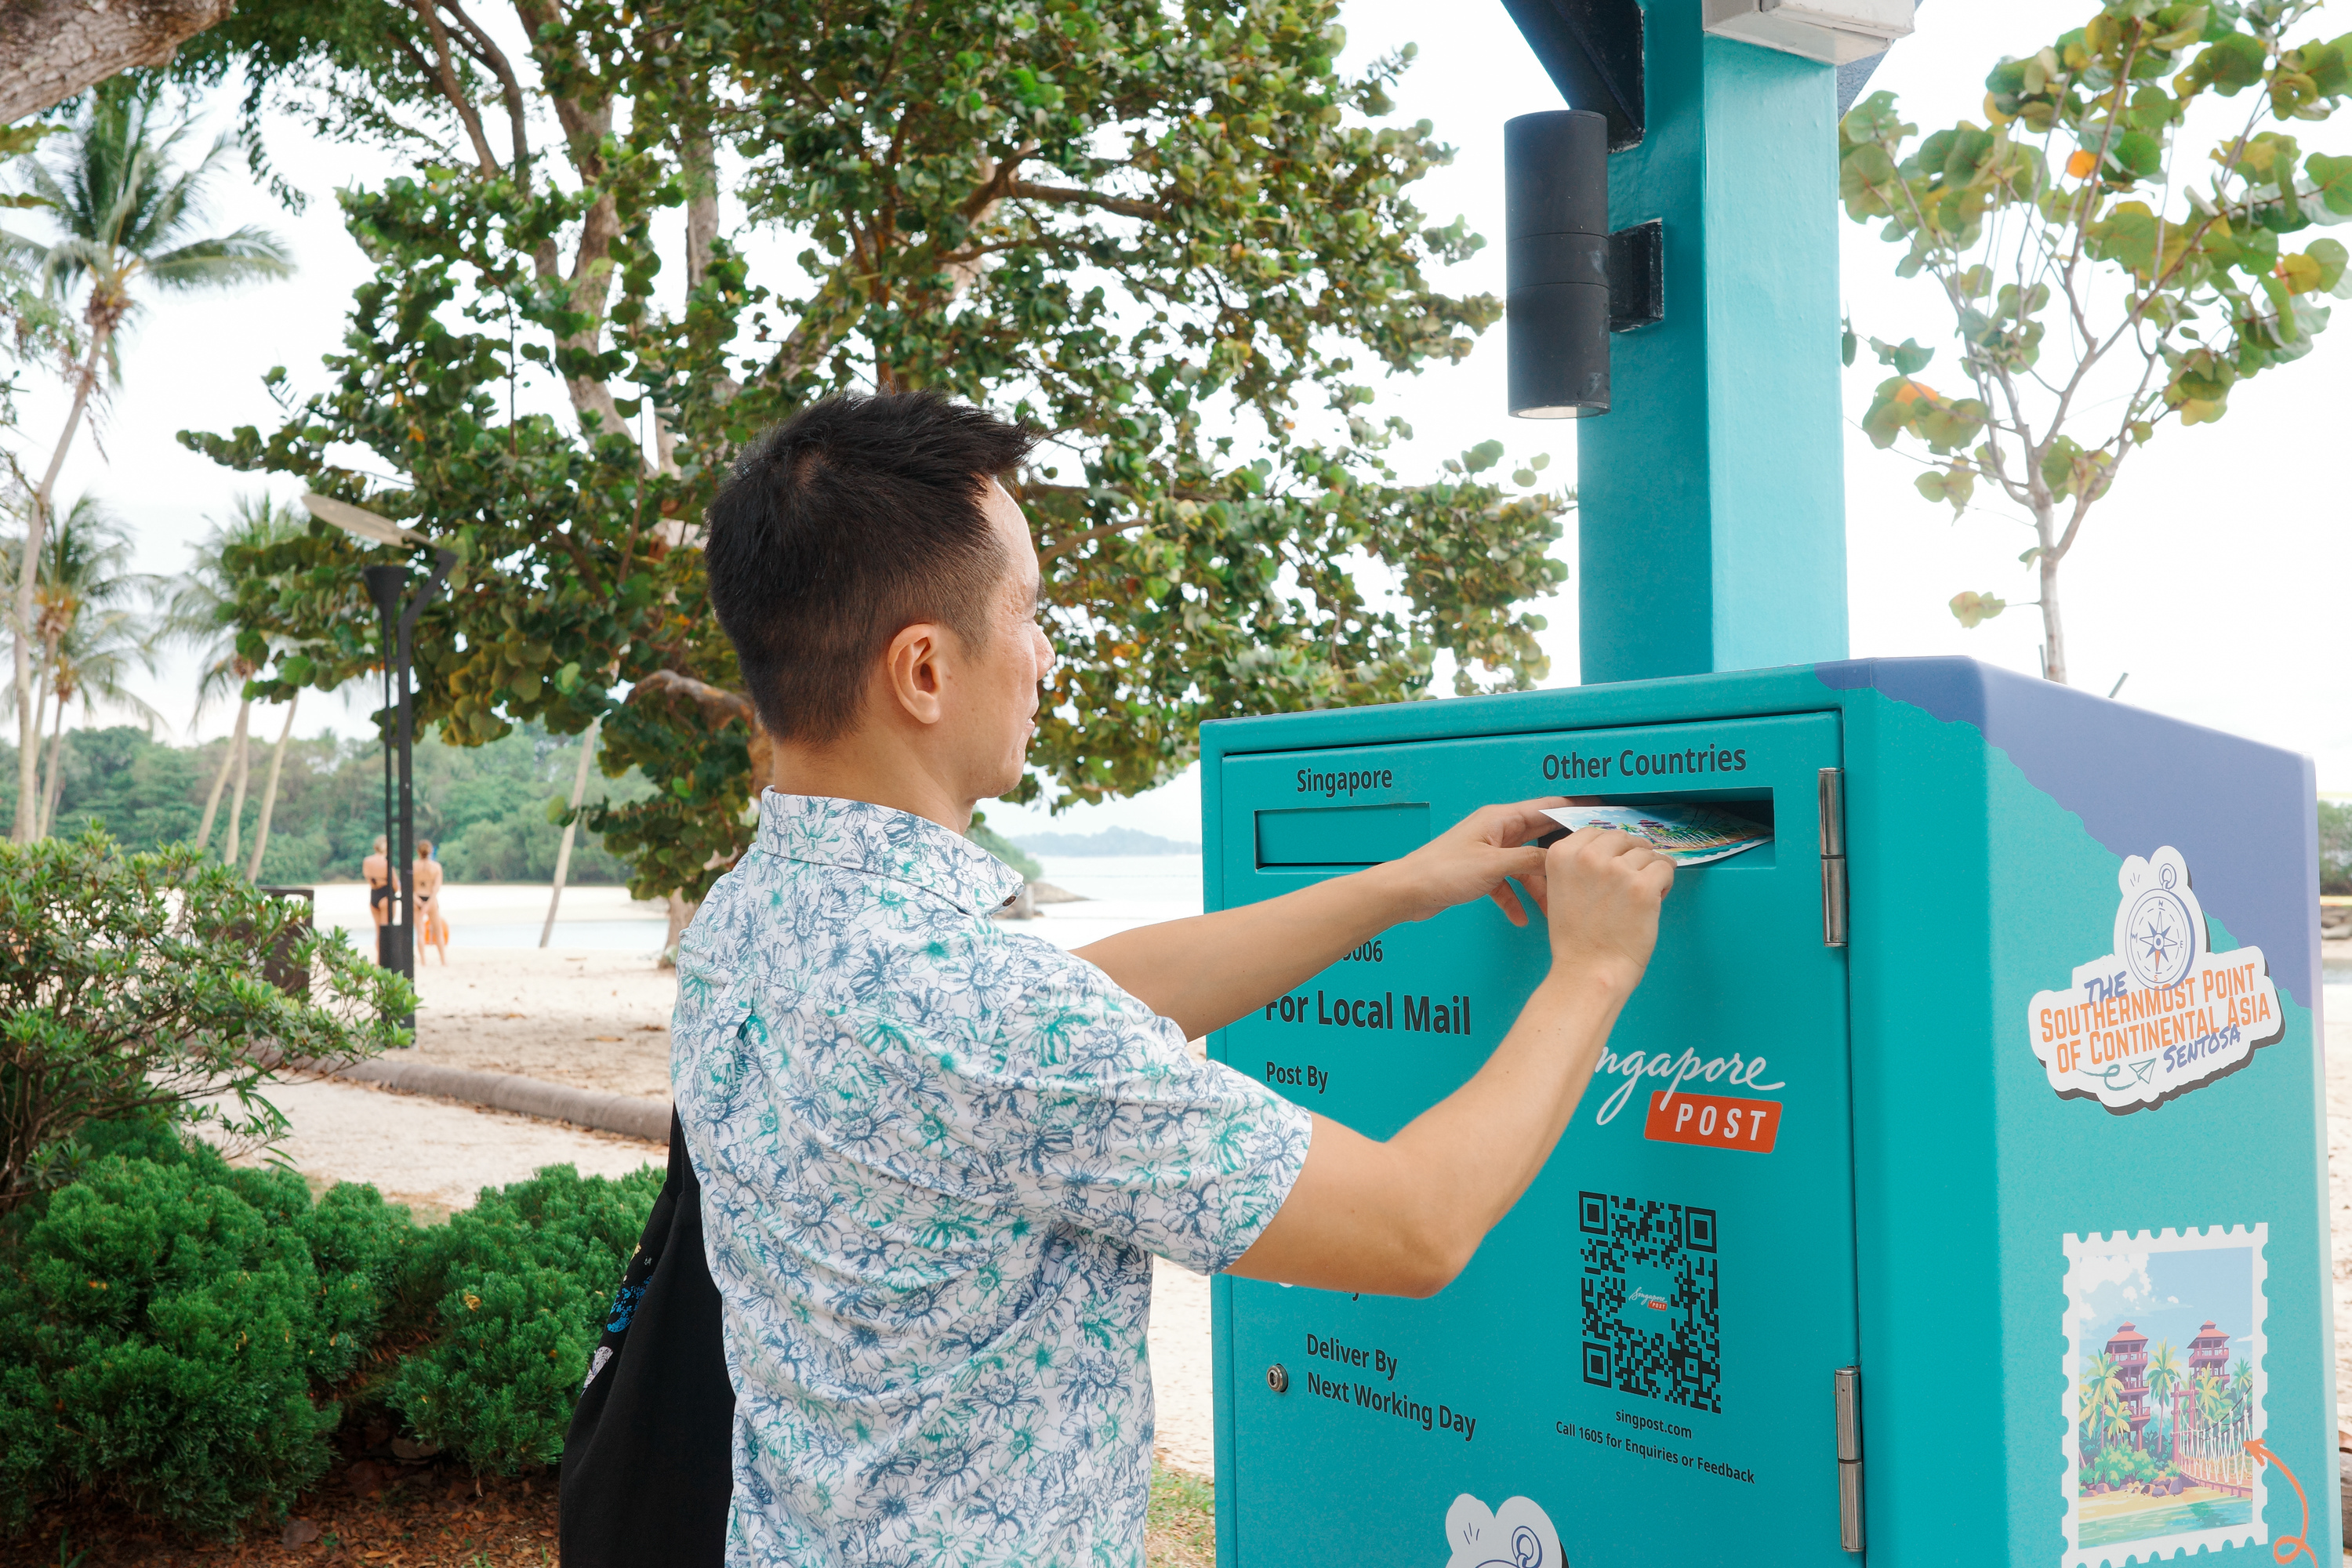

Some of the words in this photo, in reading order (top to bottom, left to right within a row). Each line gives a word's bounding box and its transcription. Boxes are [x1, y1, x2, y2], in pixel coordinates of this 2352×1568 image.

[1543, 751, 1612, 780] Other
[1620, 743, 1747, 777] Countries
[1297, 768, 1392, 798] Singapore
[2180, 940, 2183, 949] E
[2040, 977, 2195, 1043] SOUTHERNMOST
[2202, 963, 2255, 1003] POINT
[2084, 971, 2128, 1006] THE
[1265, 995, 1308, 1023] For
[1318, 990, 1393, 1030] Local
[1403, 994, 1471, 1036] Mail
[2056, 1039, 2082, 1073] OF
[2089, 1006, 2220, 1065] CONTINENTAL
[2227, 993, 2271, 1033] ASIA
[2163, 1023, 2241, 1073] SENTOSA
[1266, 1062, 1302, 1086] Post
[1307, 1065, 1329, 1094] By
[1595, 1046, 1786, 1126] ngapore
[1675, 1103, 1767, 1142] POST
[1628, 1287, 1668, 1305] Singapore
[1307, 1333, 1370, 1368] Deliver
[1375, 1348, 1398, 1381] By
[1308, 1371, 1349, 1403] Next
[1353, 1383, 1432, 1432] Working
[1439, 1404, 1476, 1443] Day
[1615, 1410, 1692, 1439] singpost.com
[1555, 1421, 1576, 1437] Call
[1579, 1427, 1603, 1444] 1605
[1606, 1433, 1622, 1449] for
[1625, 1438, 1679, 1464] Enquiries
[1682, 1455, 1694, 1468] or
[1697, 1457, 1755, 1484] Feedback
